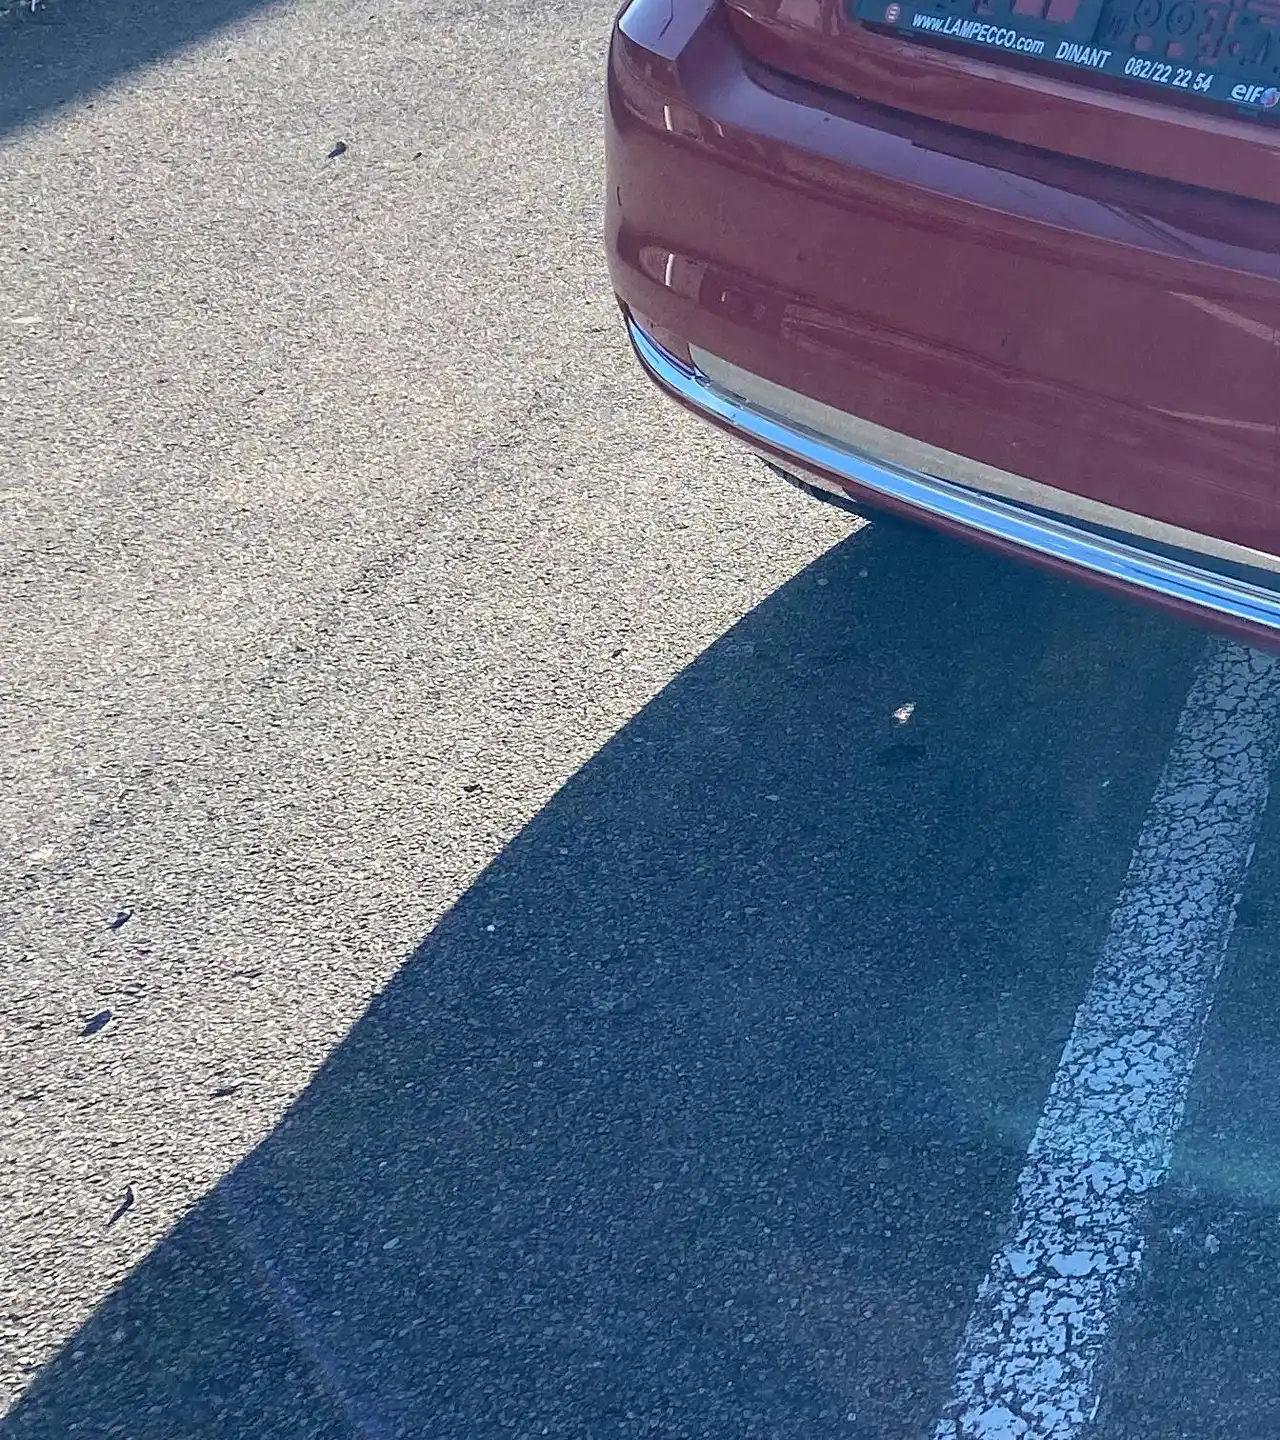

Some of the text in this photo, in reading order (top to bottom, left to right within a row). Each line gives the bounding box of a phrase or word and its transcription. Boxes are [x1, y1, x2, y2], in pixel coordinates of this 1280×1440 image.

[911, 12, 1214, 93] www.LAMPECCO.com DINANT 082/22 22 54
[1230, 83, 1263, 103] elf
